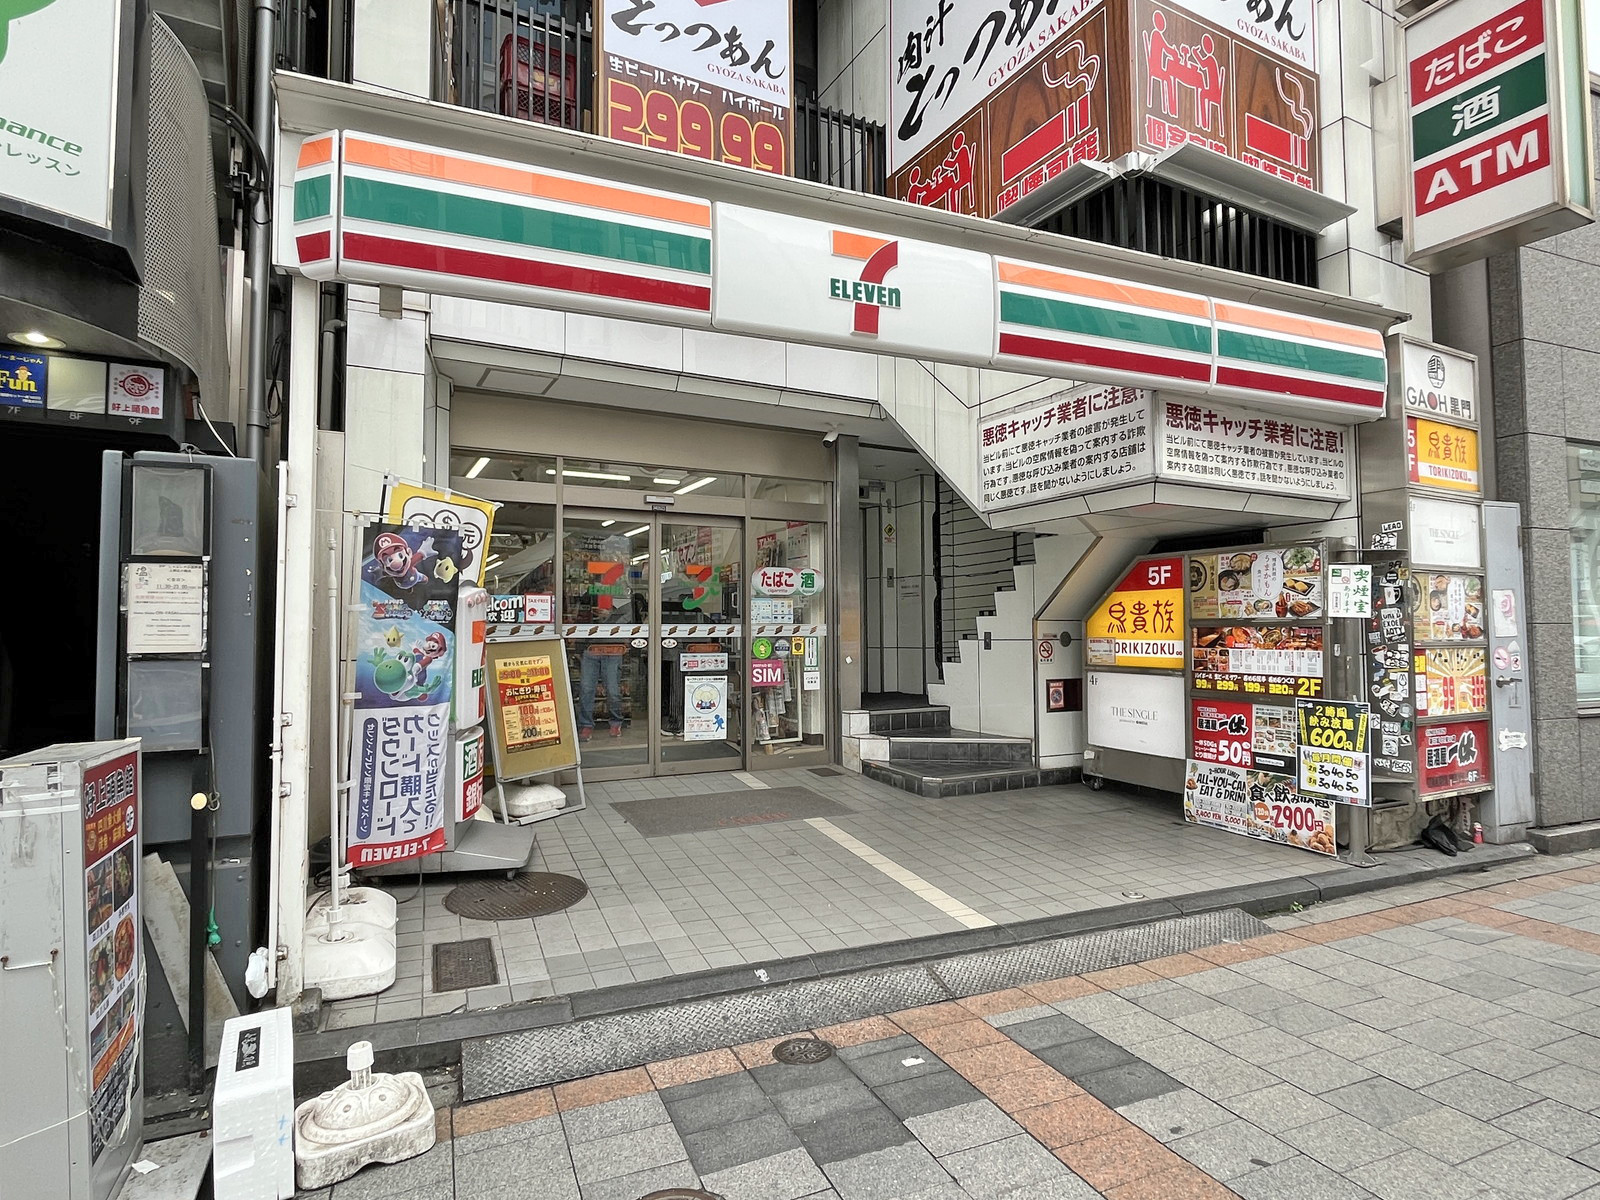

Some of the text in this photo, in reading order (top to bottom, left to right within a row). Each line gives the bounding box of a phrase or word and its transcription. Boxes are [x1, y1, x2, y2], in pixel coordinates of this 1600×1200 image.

[988, 0, 1094, 87] GYOZA SAKAB
[1236, 18, 1306, 62] GYOZA SAKABA
[1424, 16, 1528, 93] たばこ
[707, 63, 786, 96] GYOZA SAKABA
[722, 91, 785, 120] ハイボール
[1452, 85, 1501, 137] 酒
[0, 143, 81, 176] レッスン
[1424, 129, 1539, 205] ATM
[831, 230, 898, 334] 7
[128, 418, 143, 426] 9F
[1428, 465, 1468, 481] TORIKIZOKU
[761, 571, 794, 587] たばこ
[801, 572, 815, 588] 酒
[1148, 565, 1172, 586] 5F
[1353, 568, 1369, 614] 喫煙室
[1114, 642, 1176, 656] ORIKIZOKU
[752, 668, 781, 683] SIM
[1089, 675, 1098, 686] 4F
[1298, 678, 1321, 696] 2F
[1111, 706, 1159, 721] THE SINGLE
[1316, 706, 1347, 719] 2時間
[1309, 715, 1354, 730] 飲み放題
[1310, 728, 1353, 751] 600円
[465, 744, 477, 778] 酒
[1468, 771, 1478, 782] 6F
[1200, 786, 1246, 804] EAT & DRIN
[1212, 812, 1221, 820] YEN
[1272, 805, 1324, 832] 2900円
